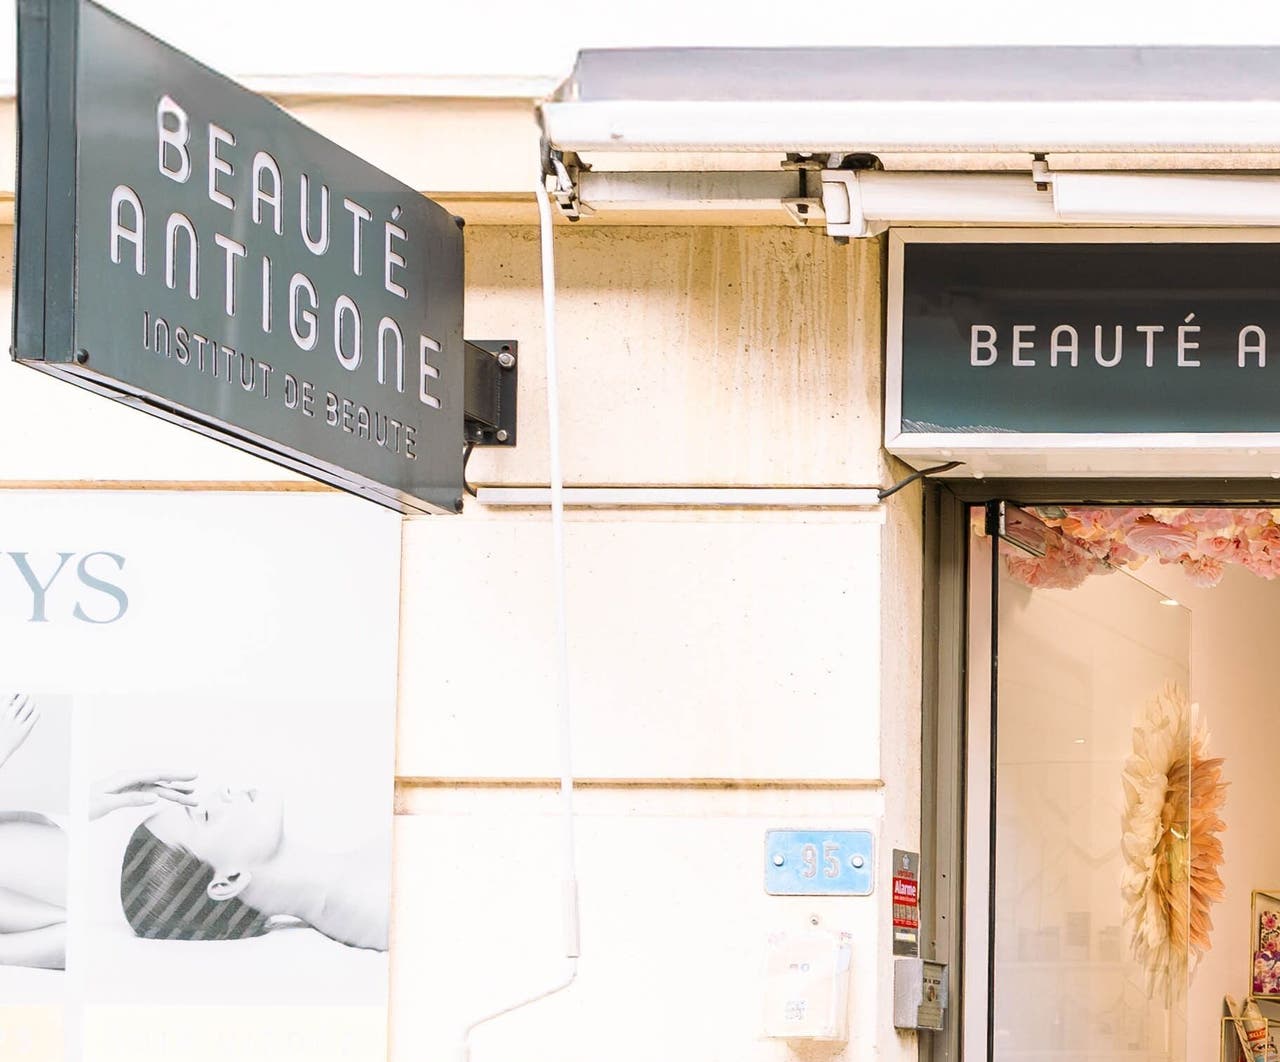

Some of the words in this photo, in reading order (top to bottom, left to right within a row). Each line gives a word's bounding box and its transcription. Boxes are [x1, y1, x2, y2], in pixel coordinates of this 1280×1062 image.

[157, 95, 408, 299] BEAUTÉ
[110, 184, 442, 409] ANTIGONE
[969, 312, 1202, 368] BEAUTÉ
[143, 310, 274, 400] INSTITUT
[283, 373, 316, 418] DE
[800, 842, 840, 878] 95
